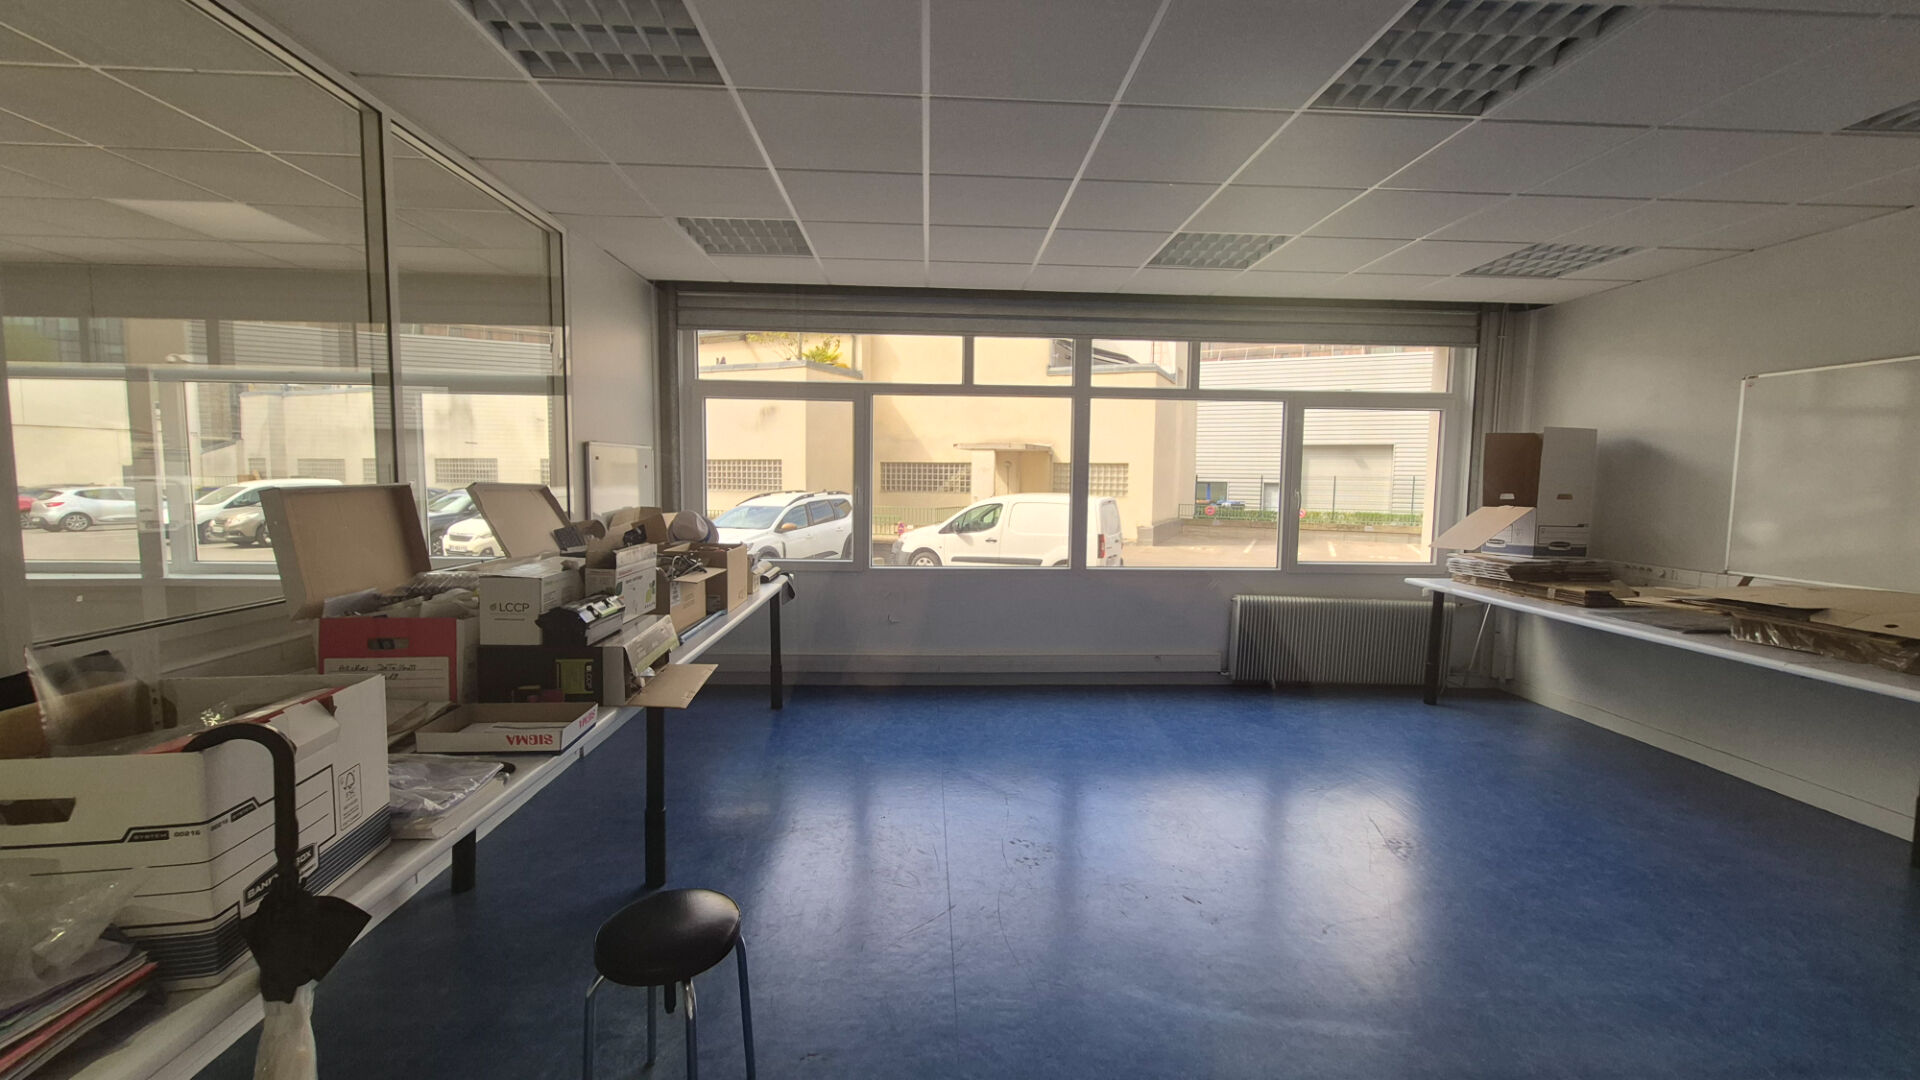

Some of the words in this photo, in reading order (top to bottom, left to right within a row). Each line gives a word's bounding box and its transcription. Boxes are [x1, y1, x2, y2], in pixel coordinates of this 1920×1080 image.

[499, 602, 530, 612] LCCP
[506, 734, 553, 746] SIGMA
[174, 829, 201, 837] 00216
